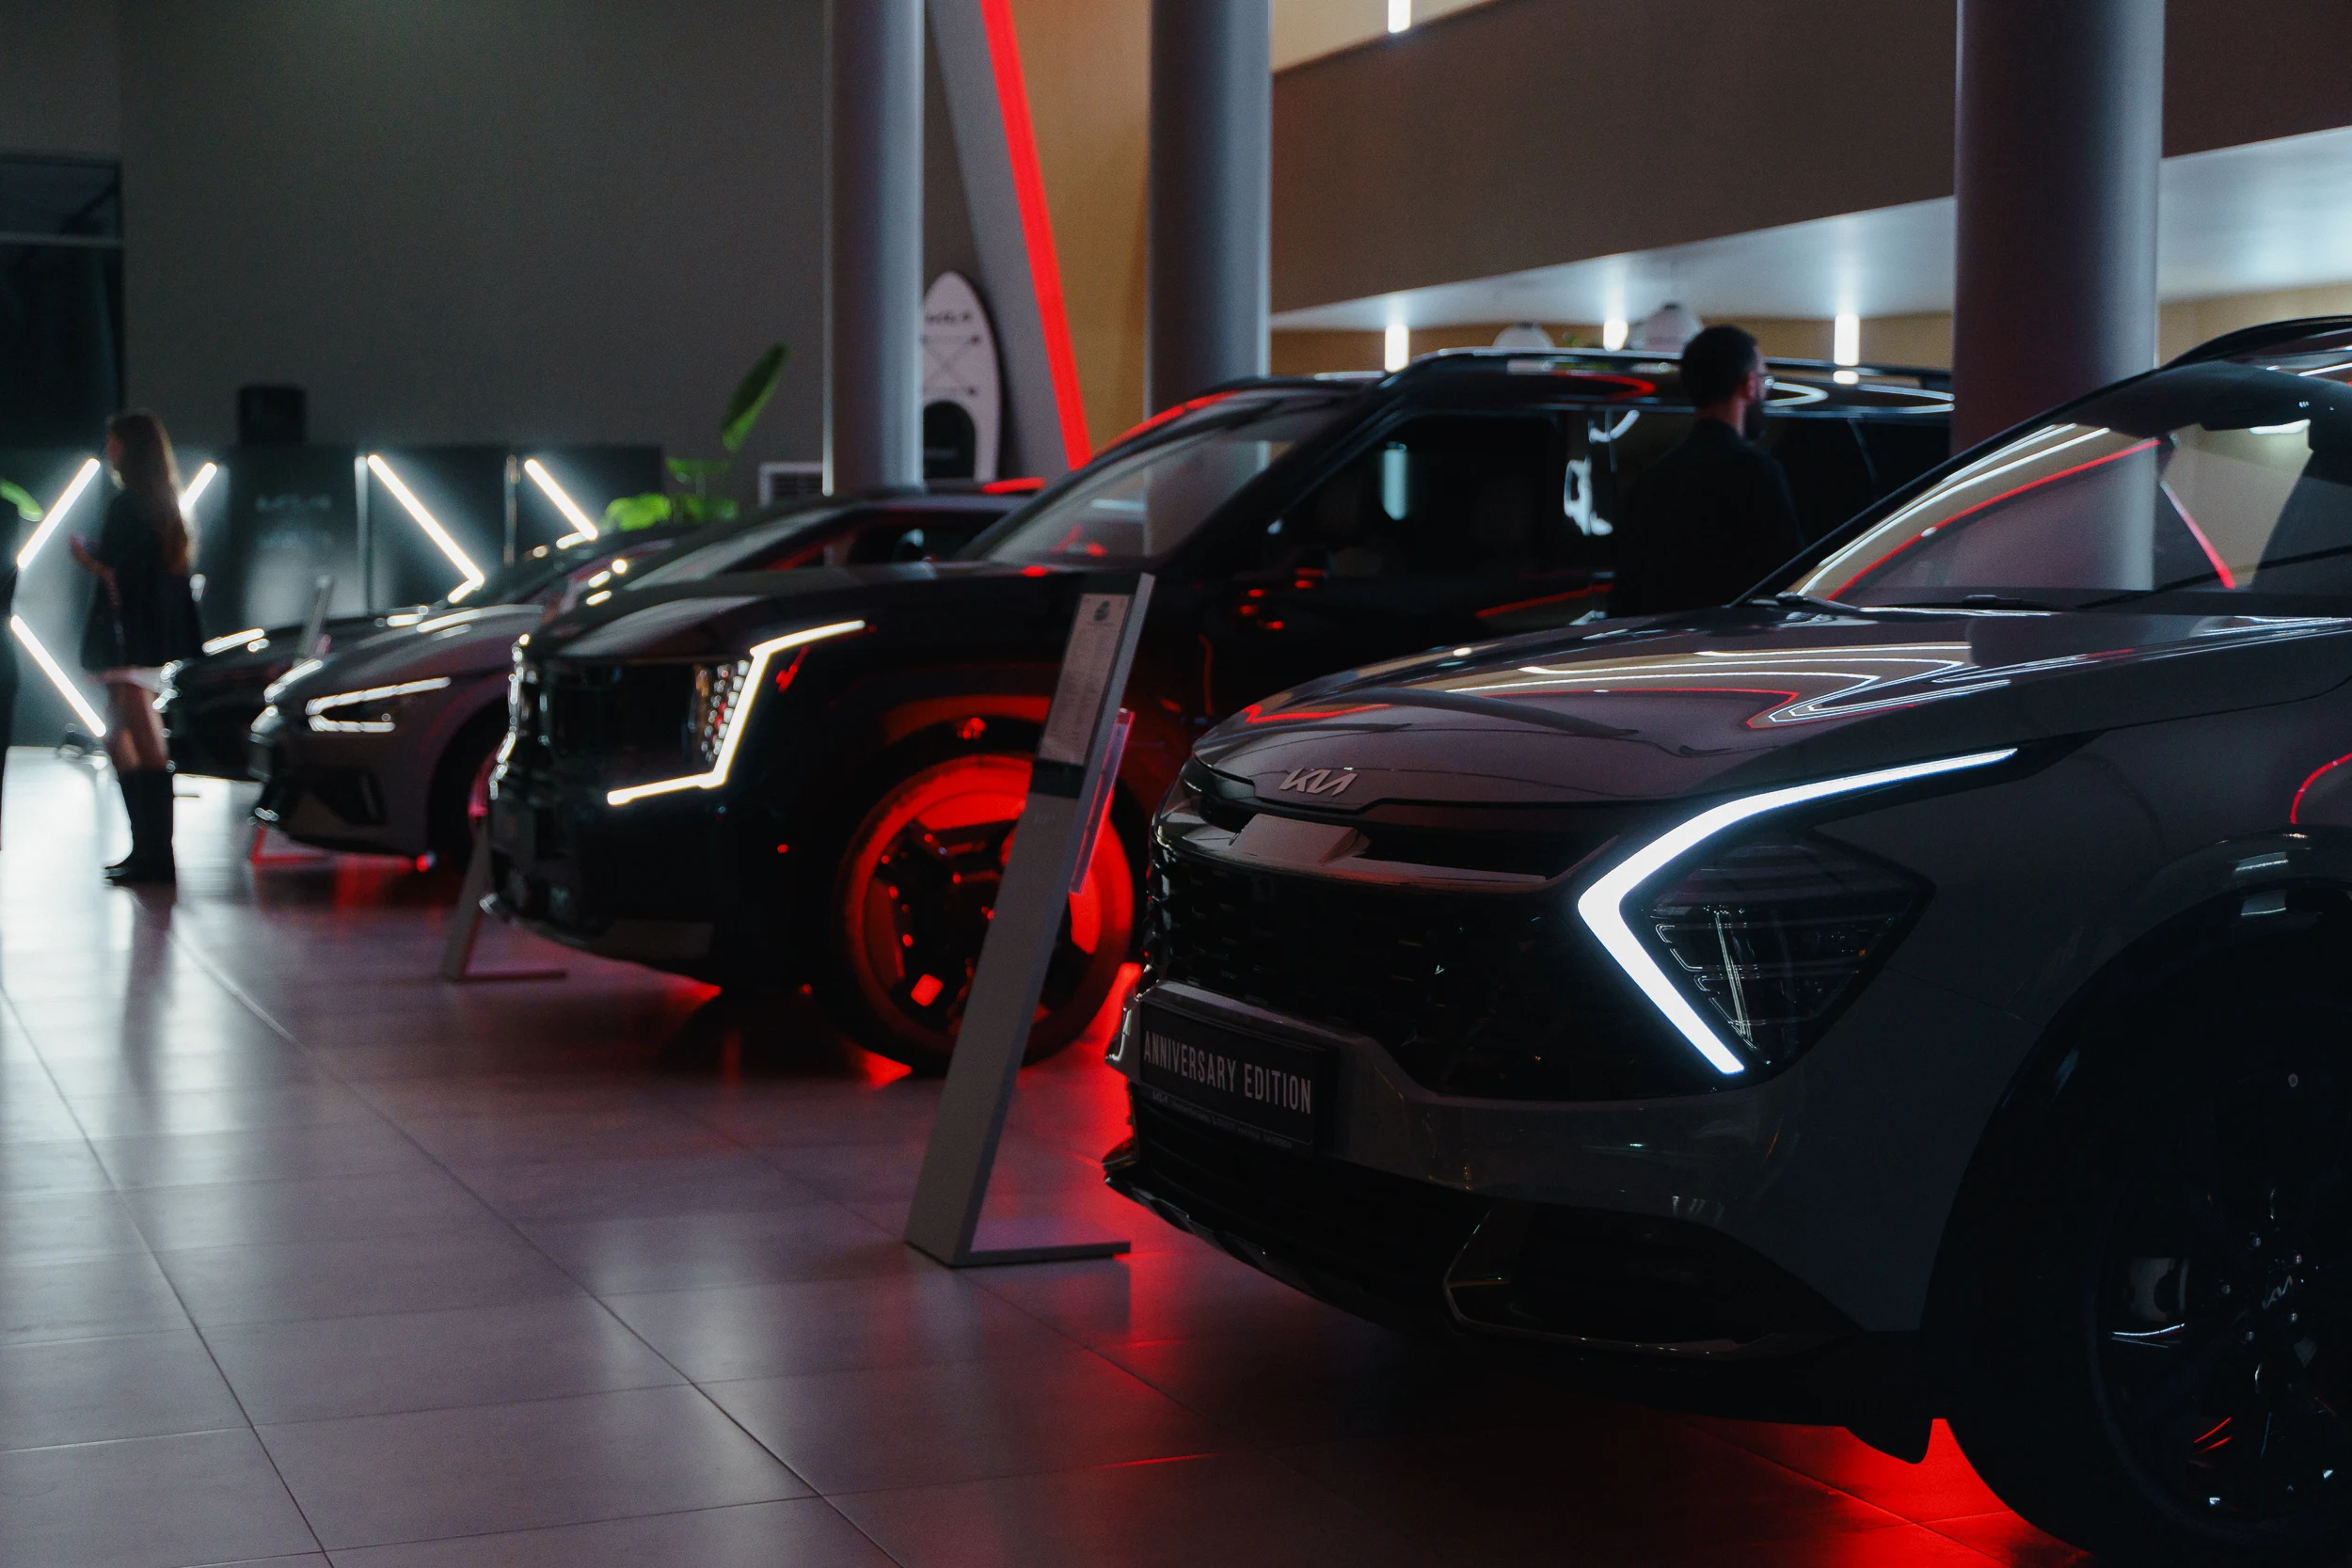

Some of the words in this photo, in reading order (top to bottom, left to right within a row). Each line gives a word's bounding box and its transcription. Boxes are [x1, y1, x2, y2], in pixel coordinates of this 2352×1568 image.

[1279, 768, 1358, 797] KIA
[1143, 1031, 1236, 1093] ANNIVERSARY
[1244, 1062, 1311, 1115] EDITION
